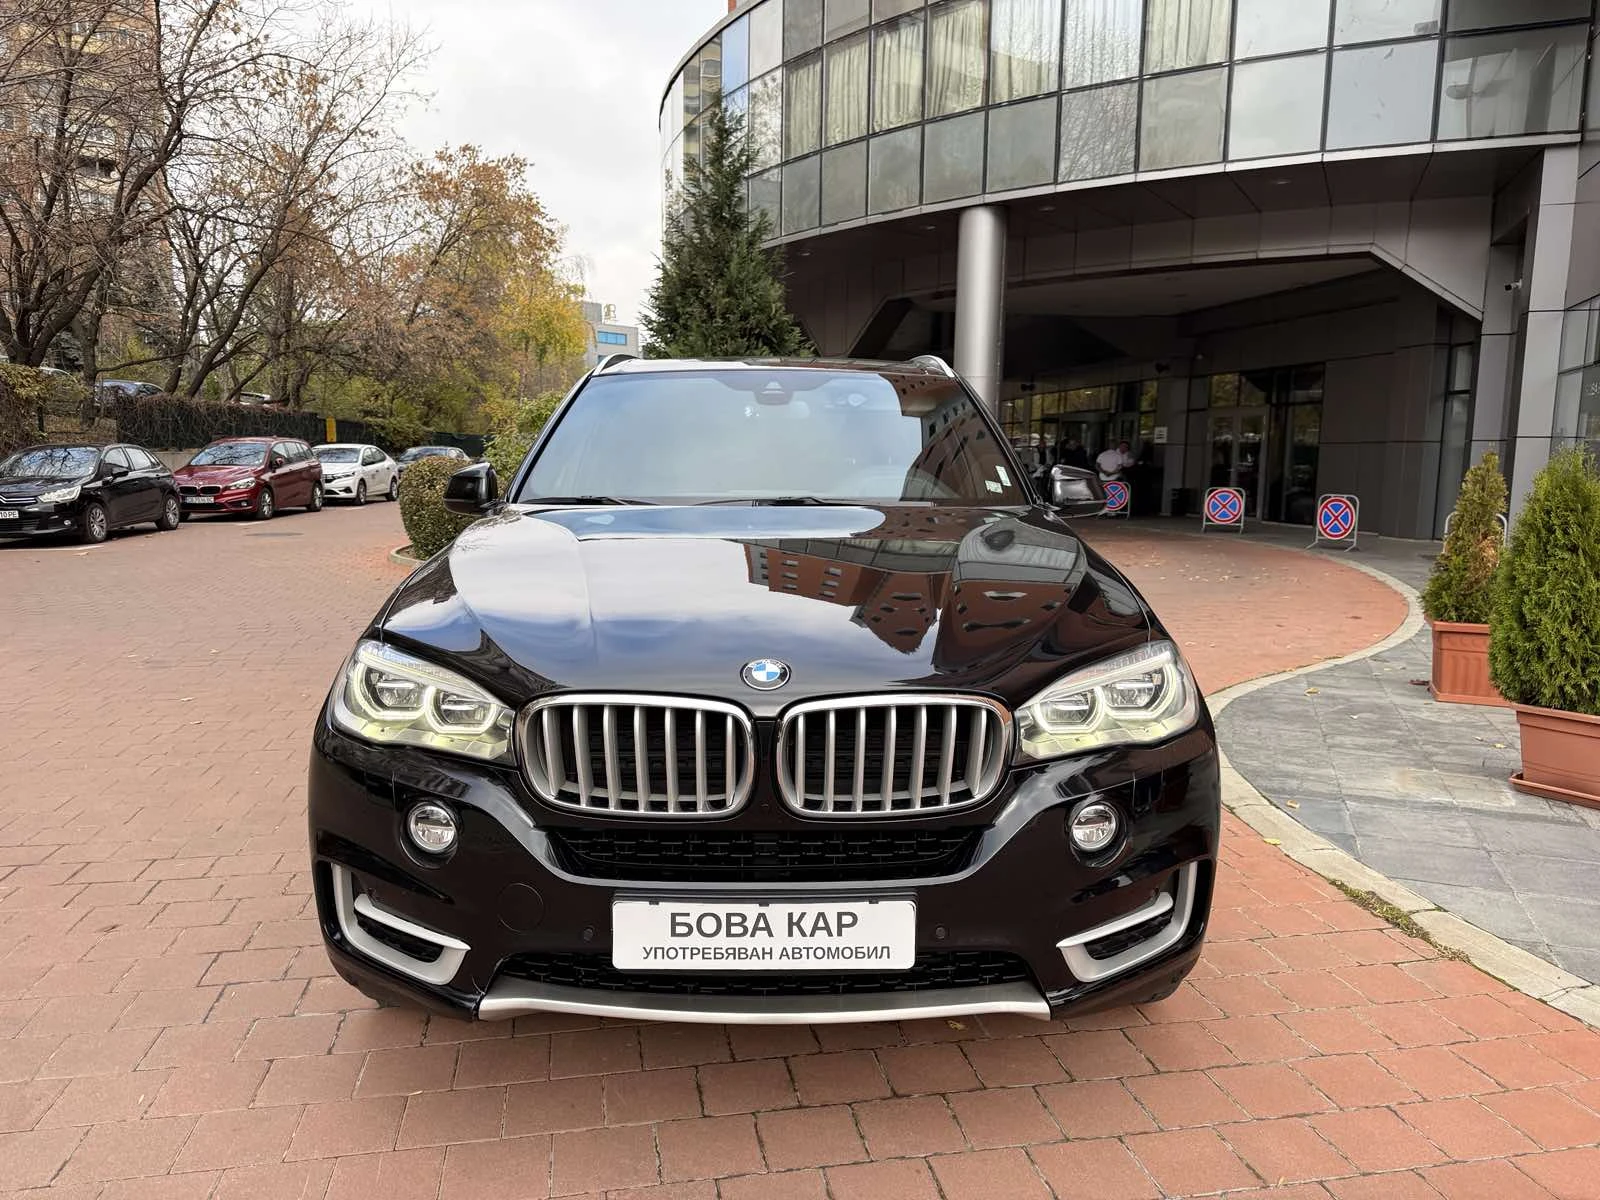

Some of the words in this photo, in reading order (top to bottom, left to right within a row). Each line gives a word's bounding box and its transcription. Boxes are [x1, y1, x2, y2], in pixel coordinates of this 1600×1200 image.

[671, 912, 774, 937] БОВА
[788, 912, 858, 937] КАР
[643, 946, 772, 960] УПОТРЕБЯВАН
[779, 945, 890, 960] АВТОМОБИЛ
